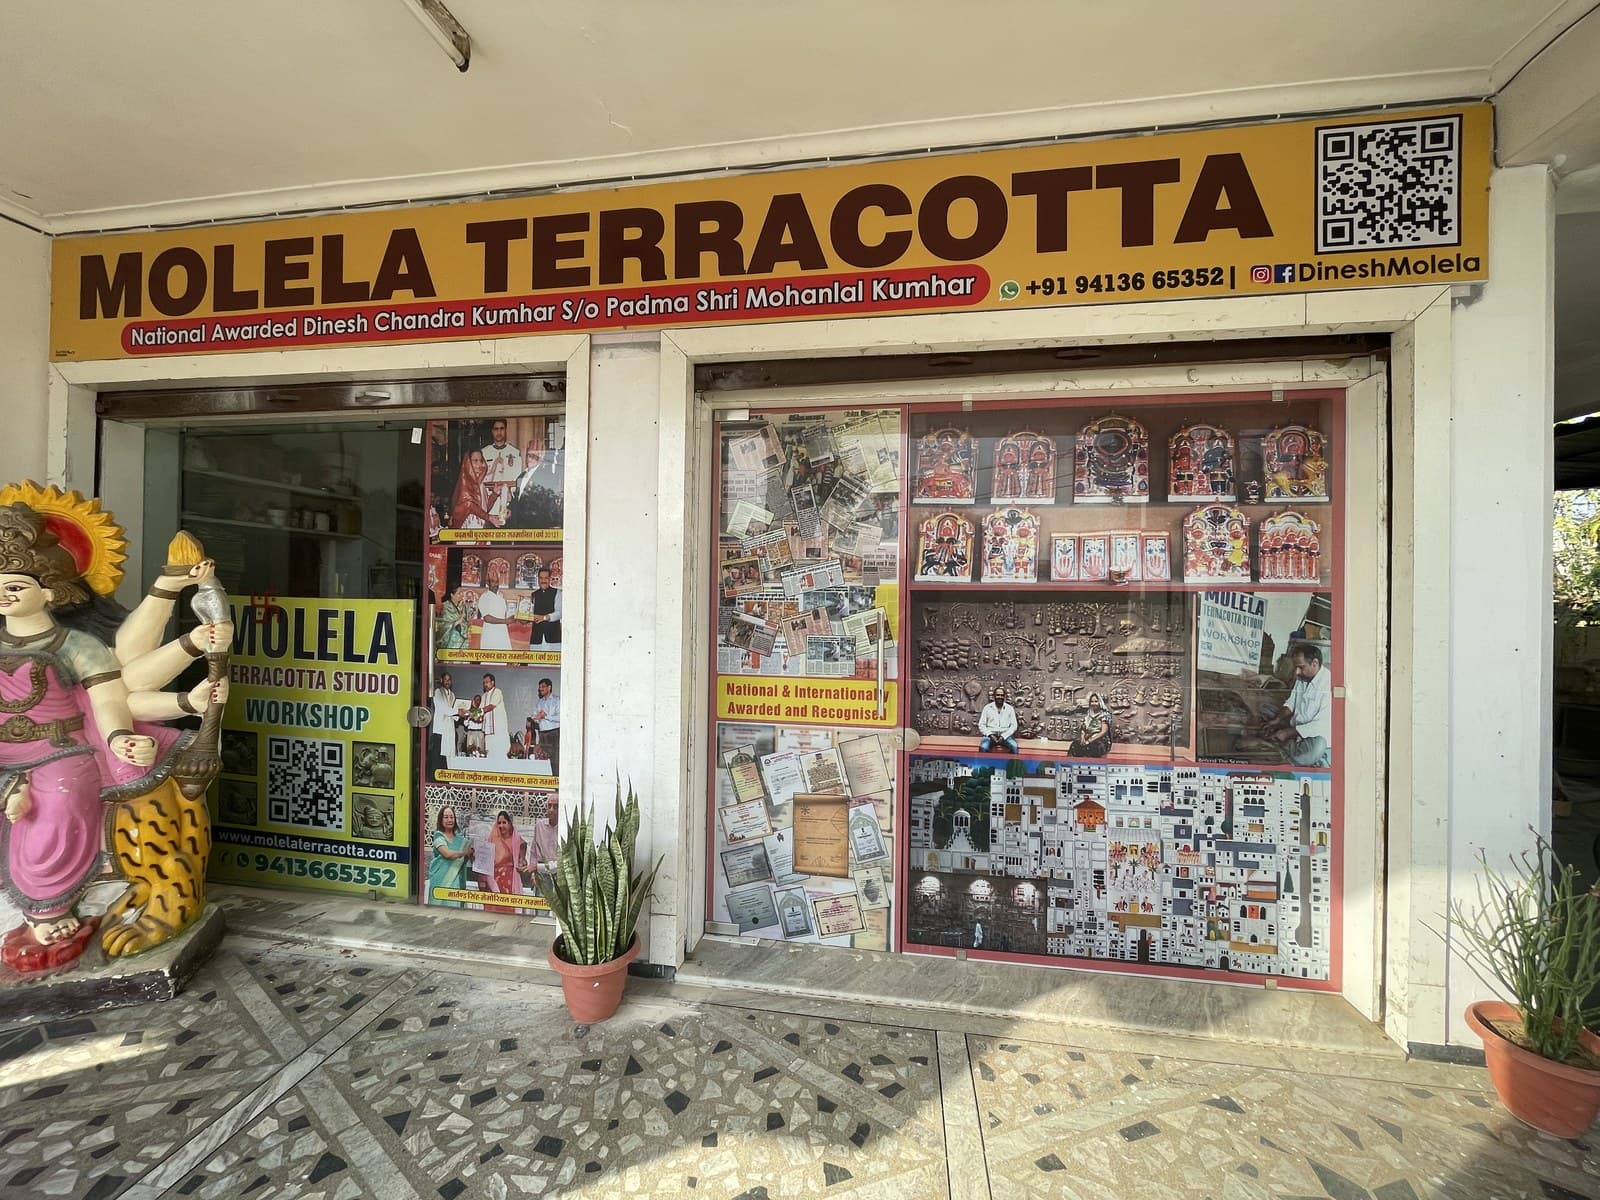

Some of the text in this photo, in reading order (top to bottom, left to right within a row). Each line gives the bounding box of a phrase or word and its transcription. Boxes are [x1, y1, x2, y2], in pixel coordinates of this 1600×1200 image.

[79, 152, 1274, 320] MOLELA TERRACOTTA
[1025, 278, 1068, 297] +91
[1075, 272, 1146, 294] 94136
[1152, 266, 1224, 290] 65352
[1299, 253, 1481, 283] DineshMolela
[130, 273, 976, 348] National Awarded Dinesh Chandra Kumhar S/o Padma Shri Mohanlal Kumhar
[230, 605, 399, 665] MOLELA
[1202, 628, 1261, 649] WORKSHOP
[1242, 616, 1263, 630] STUDIO
[229, 664, 400, 695] ERRACOTTA STUDIO
[726, 682, 889, 703] National & Internationaly
[246, 699, 370, 731] WORKSHOP
[727, 702, 781, 716] Awarded
[785, 703, 808, 717] and
[219, 831, 398, 861] www.molelaterracotta.com
[254, 853, 397, 888] 9413665352
